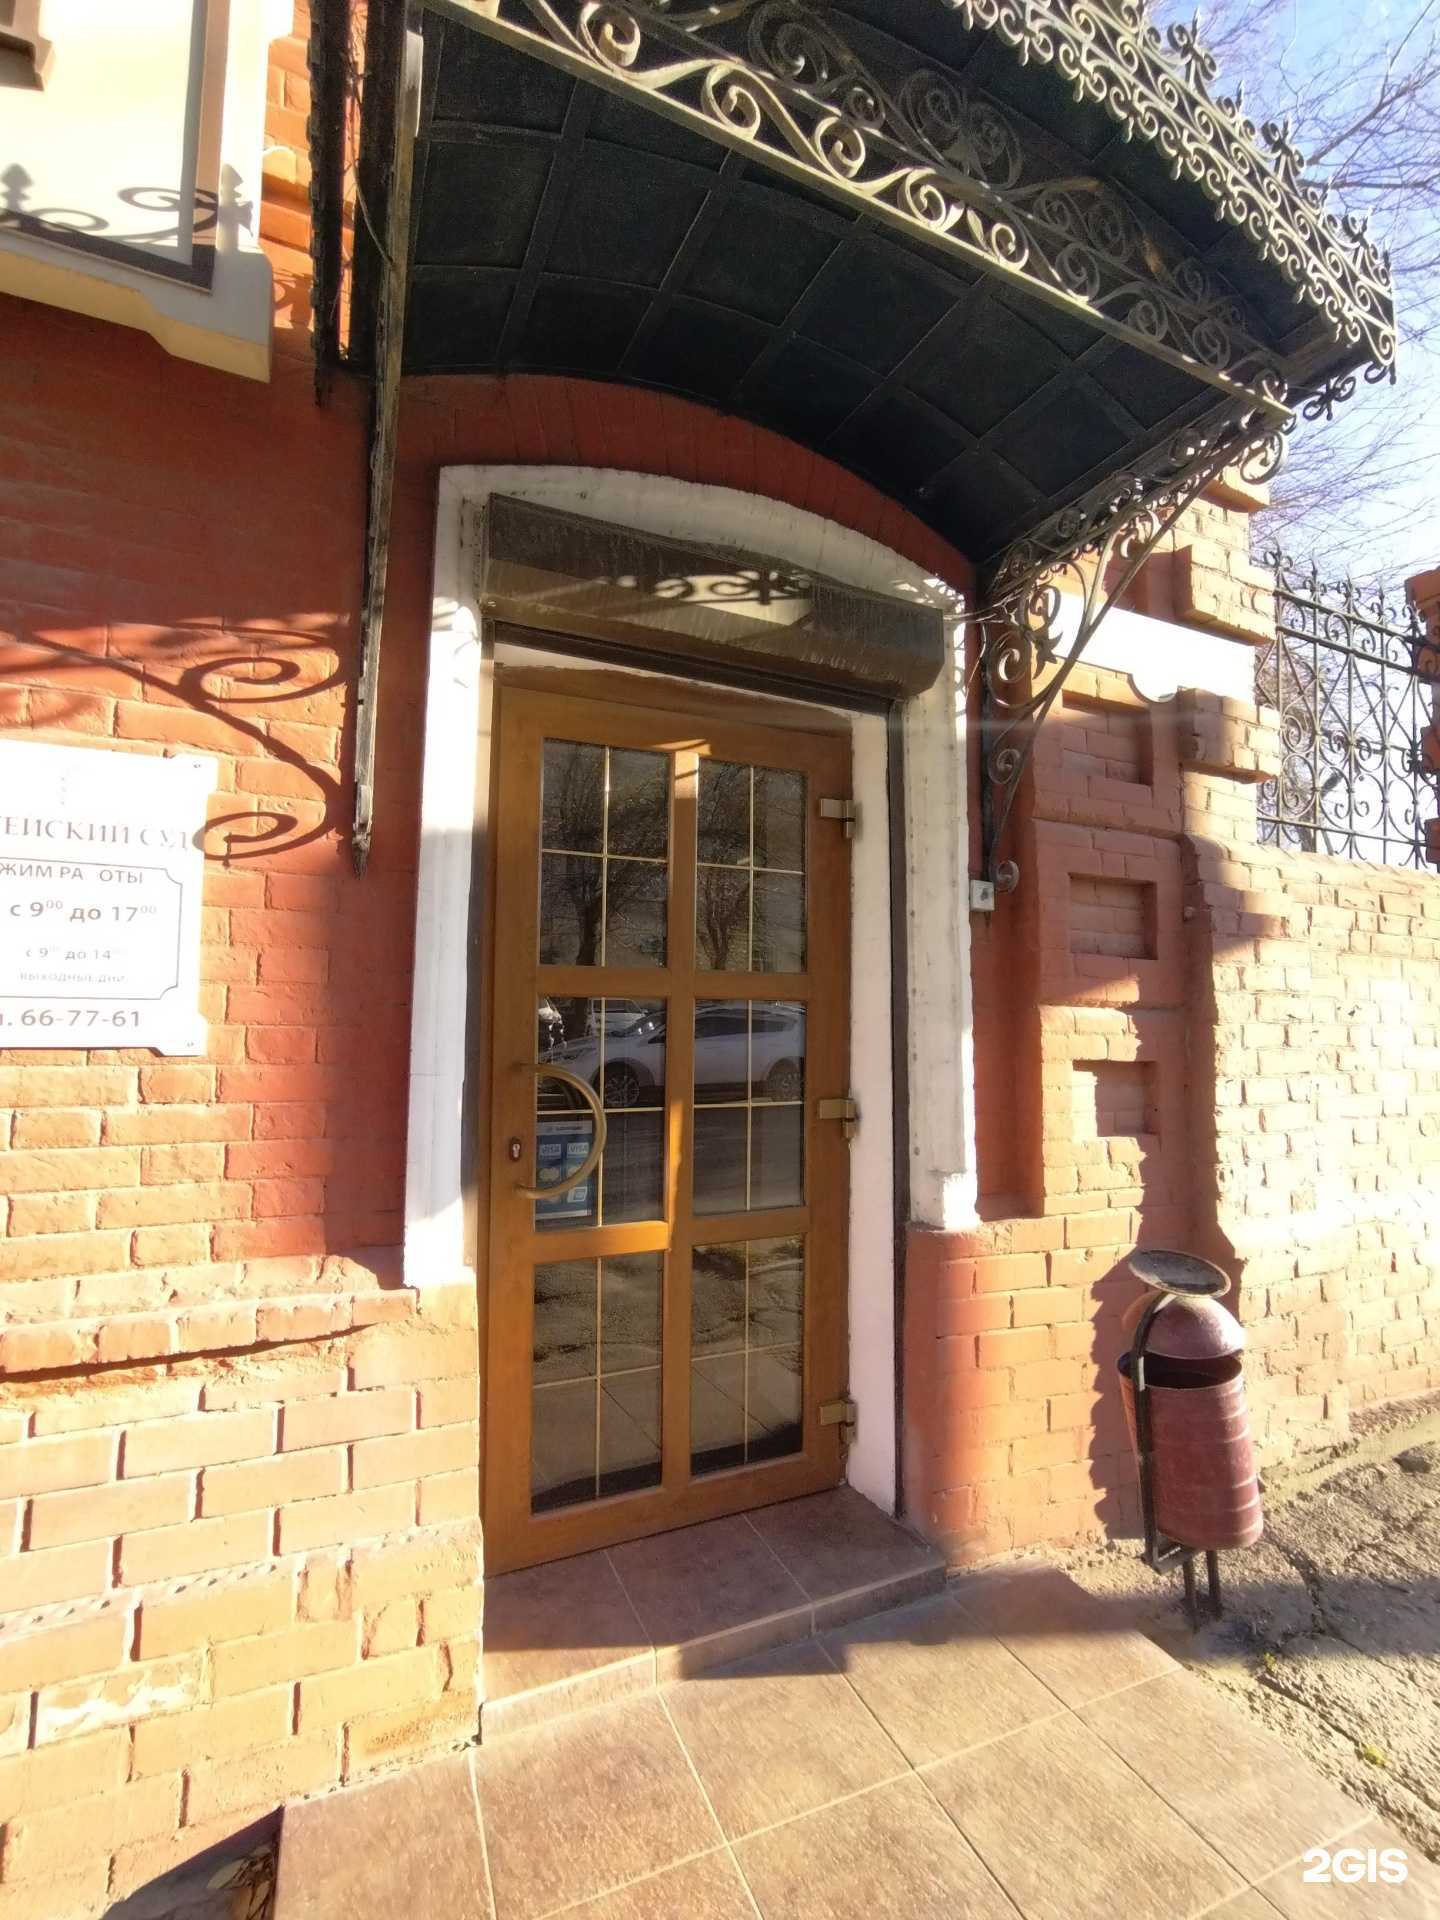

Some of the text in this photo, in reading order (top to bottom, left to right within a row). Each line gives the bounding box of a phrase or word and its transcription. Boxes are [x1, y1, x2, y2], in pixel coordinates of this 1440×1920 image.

[0, 817, 129, 843] ЕЙСКИЙ
[59, 866, 143, 884] РАОТЫ
[69, 907, 102, 923] до
[64, 949, 87, 961] до
[20, 1009, 141, 1028] 66-77-61
